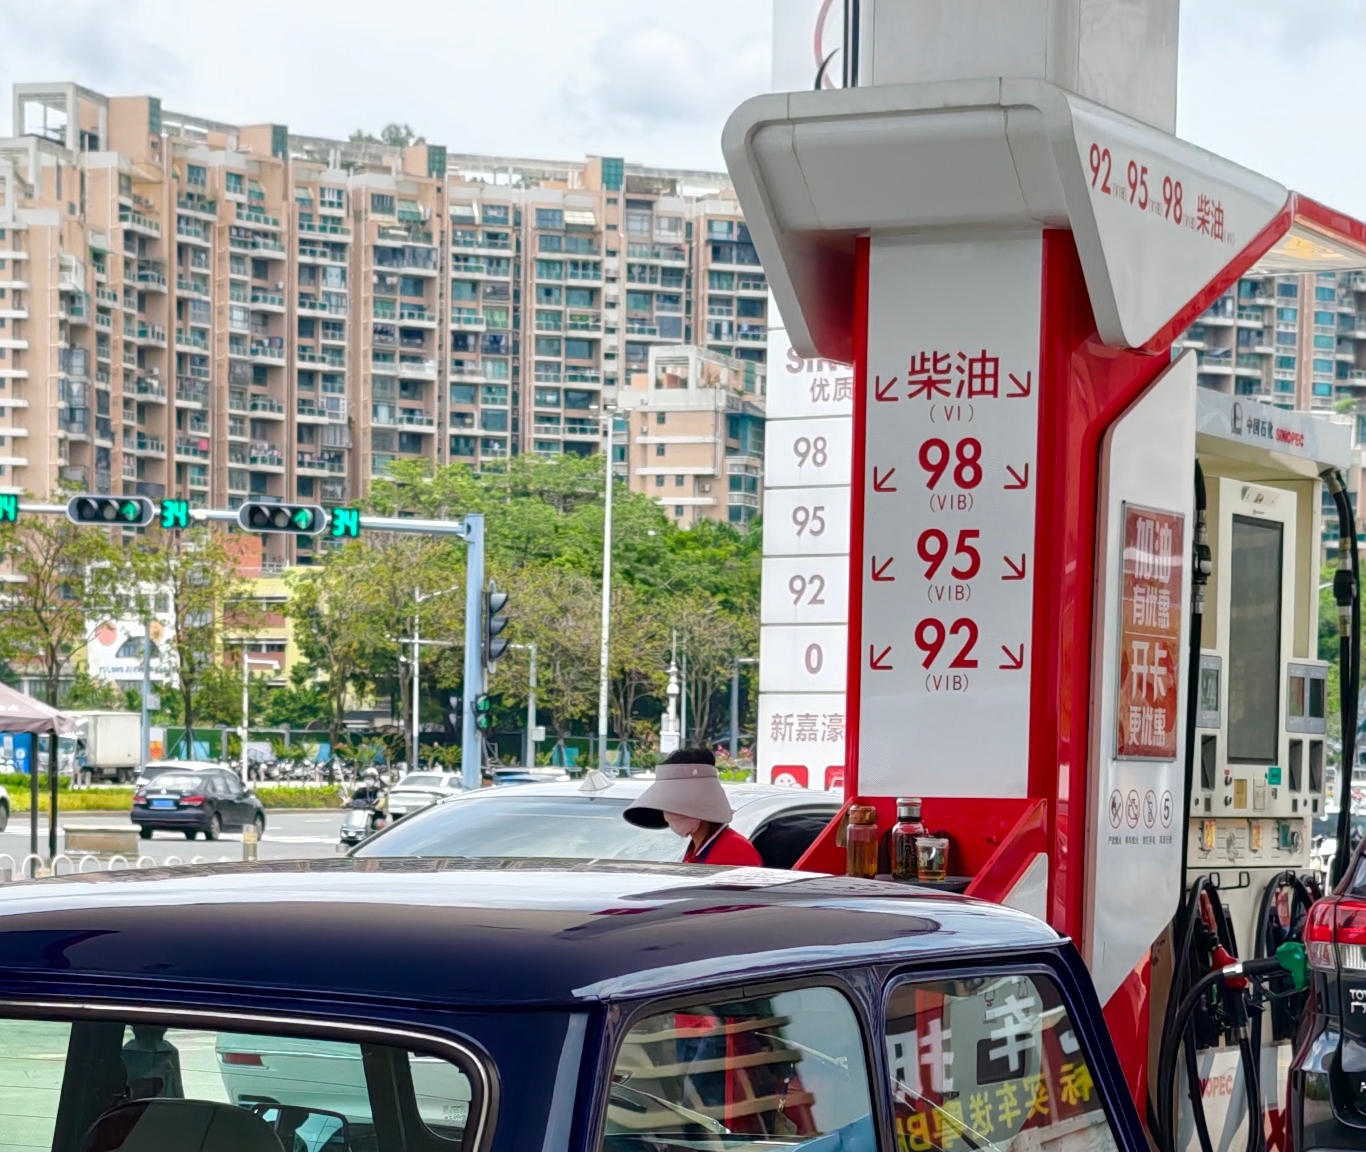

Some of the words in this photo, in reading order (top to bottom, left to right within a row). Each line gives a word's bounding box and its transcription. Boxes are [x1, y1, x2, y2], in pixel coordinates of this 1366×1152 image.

[1090, 143, 1112, 195] 92
[1128, 160, 1148, 210] 95
[1162, 176, 1183, 224] 98
[1196, 194, 1224, 243] 柴油
[810, 377, 853, 403] 优质
[907, 350, 999, 399] 柴油
[930, 404, 974, 423] (VI)
[794, 436, 827, 468] 98
[1276, 428, 1304, 447] SINOPEC
[918, 438, 982, 490] 98
[162, 499, 188, 528] 34
[929, 493, 973, 512] (VIB)
[334, 508, 359, 537] 34
[792, 506, 825, 537] 95
[917, 529, 980, 580] 95
[1135, 516, 1173, 584] 加油
[789, 575, 825, 606] 92
[928, 584, 971, 602] (VIB)
[1132, 585, 1171, 630] 有优惠
[805, 643, 823, 674] 0
[915, 618, 978, 669] 92
[926, 674, 969, 692] (VIB)
[1130, 640, 1168, 702] 开卡
[1128, 705, 1167, 748] 更优惠
[1163, 797, 1170, 821] 5
